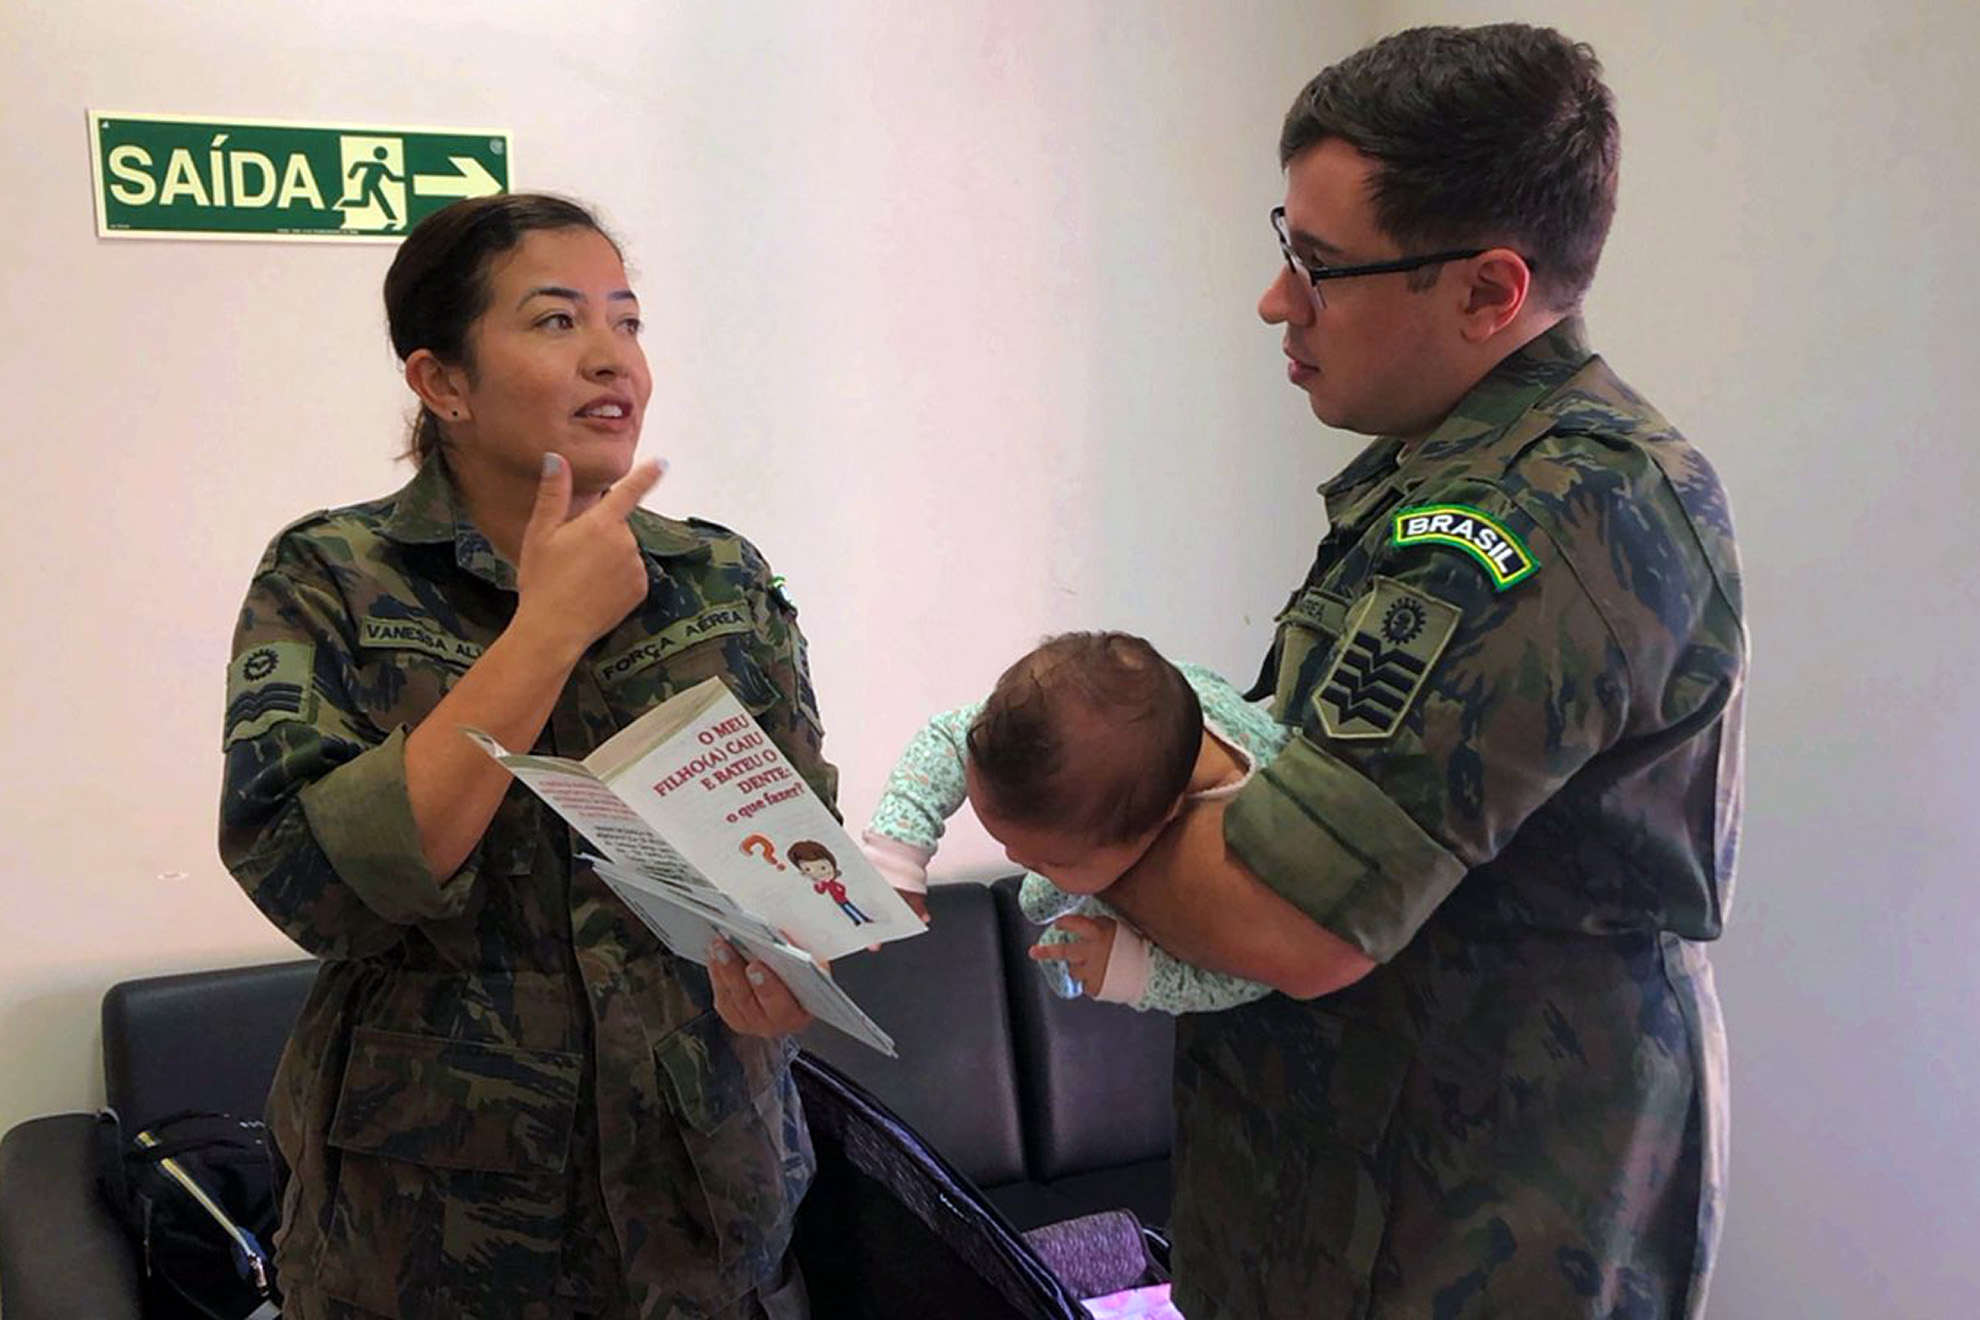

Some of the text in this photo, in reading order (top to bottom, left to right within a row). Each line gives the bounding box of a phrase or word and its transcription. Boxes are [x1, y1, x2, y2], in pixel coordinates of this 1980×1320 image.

[108, 133, 325, 210] SAÍDA
[1407, 514, 1516, 574] BRASIL
[366, 624, 447, 652] VANESSA
[602, 610, 745, 681] FORÇA AÉREA
[698, 714, 750, 745] O MEU
[653, 731, 764, 797] FILHO(A) CAIU
[700, 749, 778, 791] E BATEU O
[737, 766, 793, 794] DENTE:
[726, 782, 805, 823] o que fazer?
